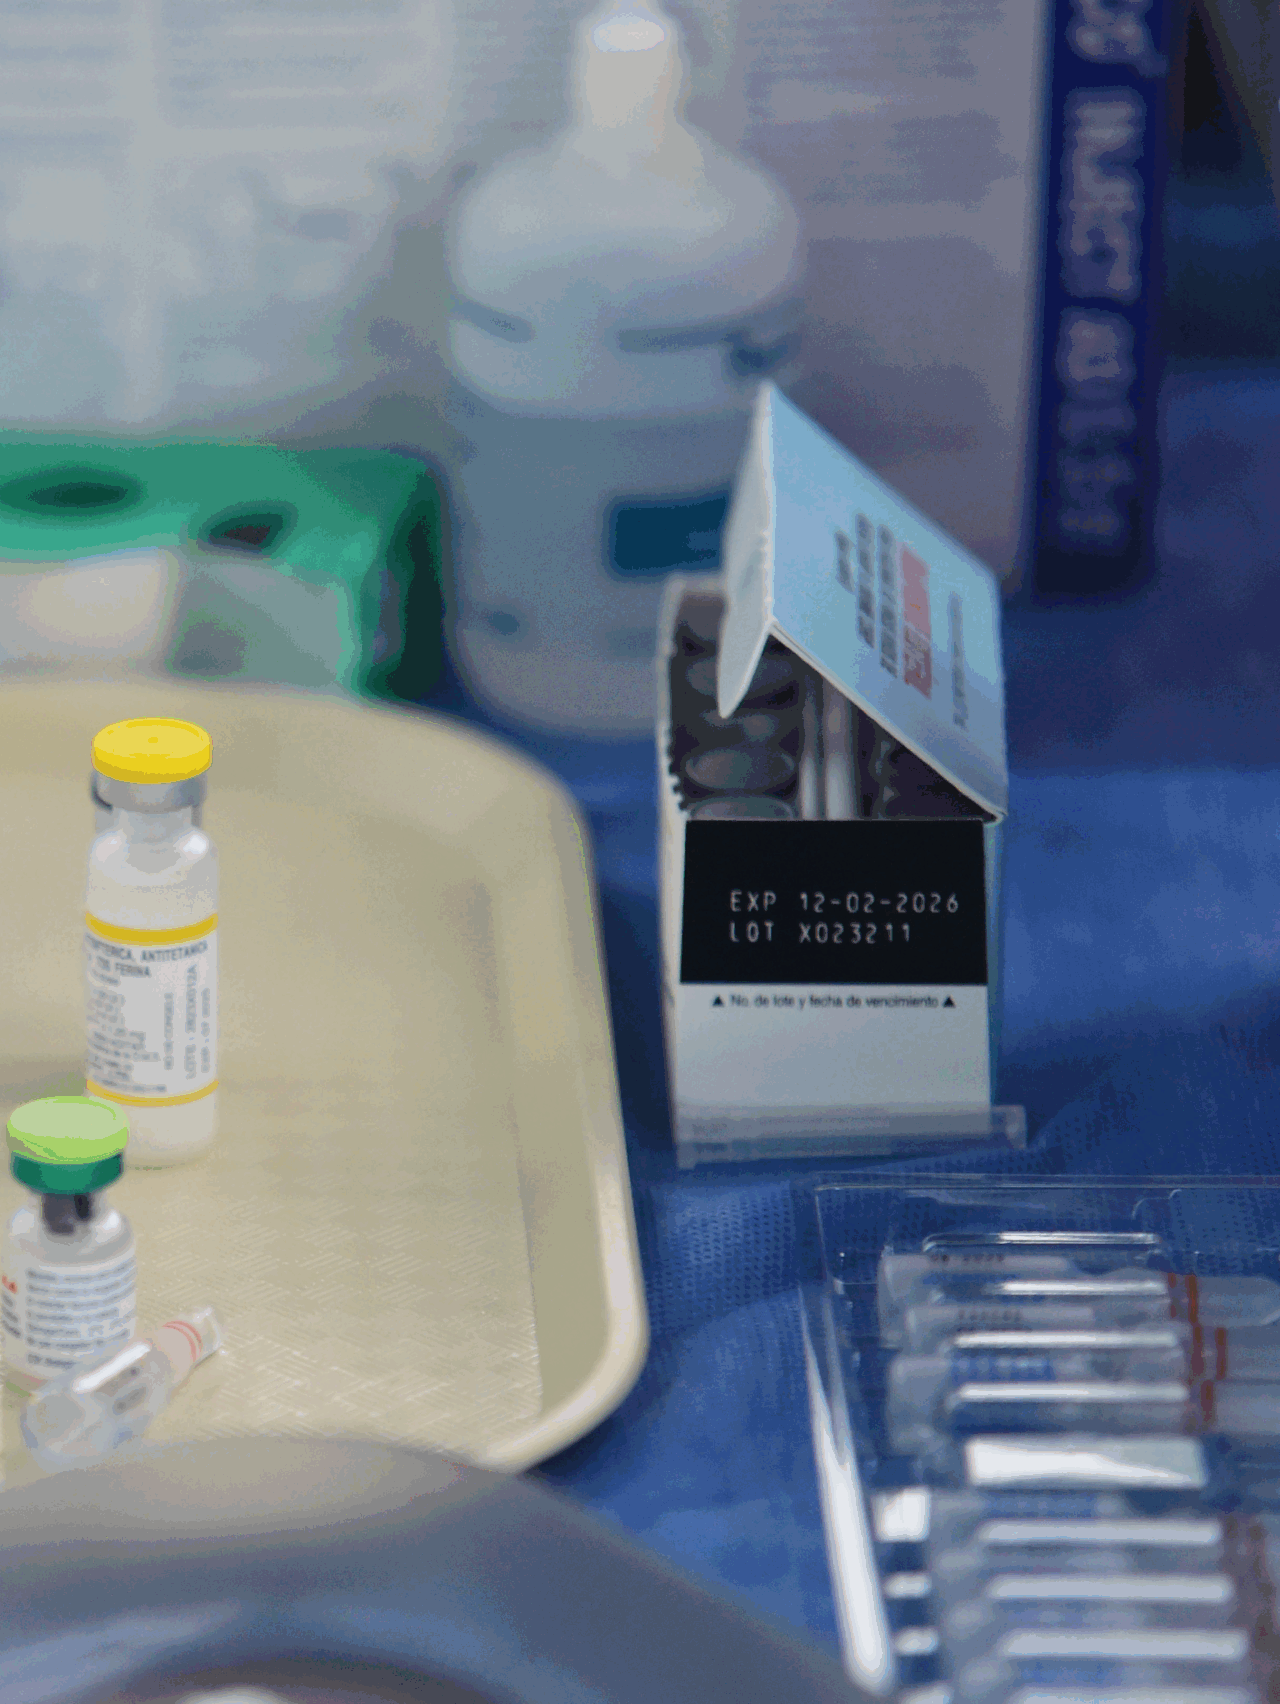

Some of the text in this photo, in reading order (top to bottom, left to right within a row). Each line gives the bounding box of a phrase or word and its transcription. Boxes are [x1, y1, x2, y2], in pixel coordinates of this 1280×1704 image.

[730, 889, 959, 914] EXP 12-02-2026
[730, 920, 911, 944] LOT X023211
